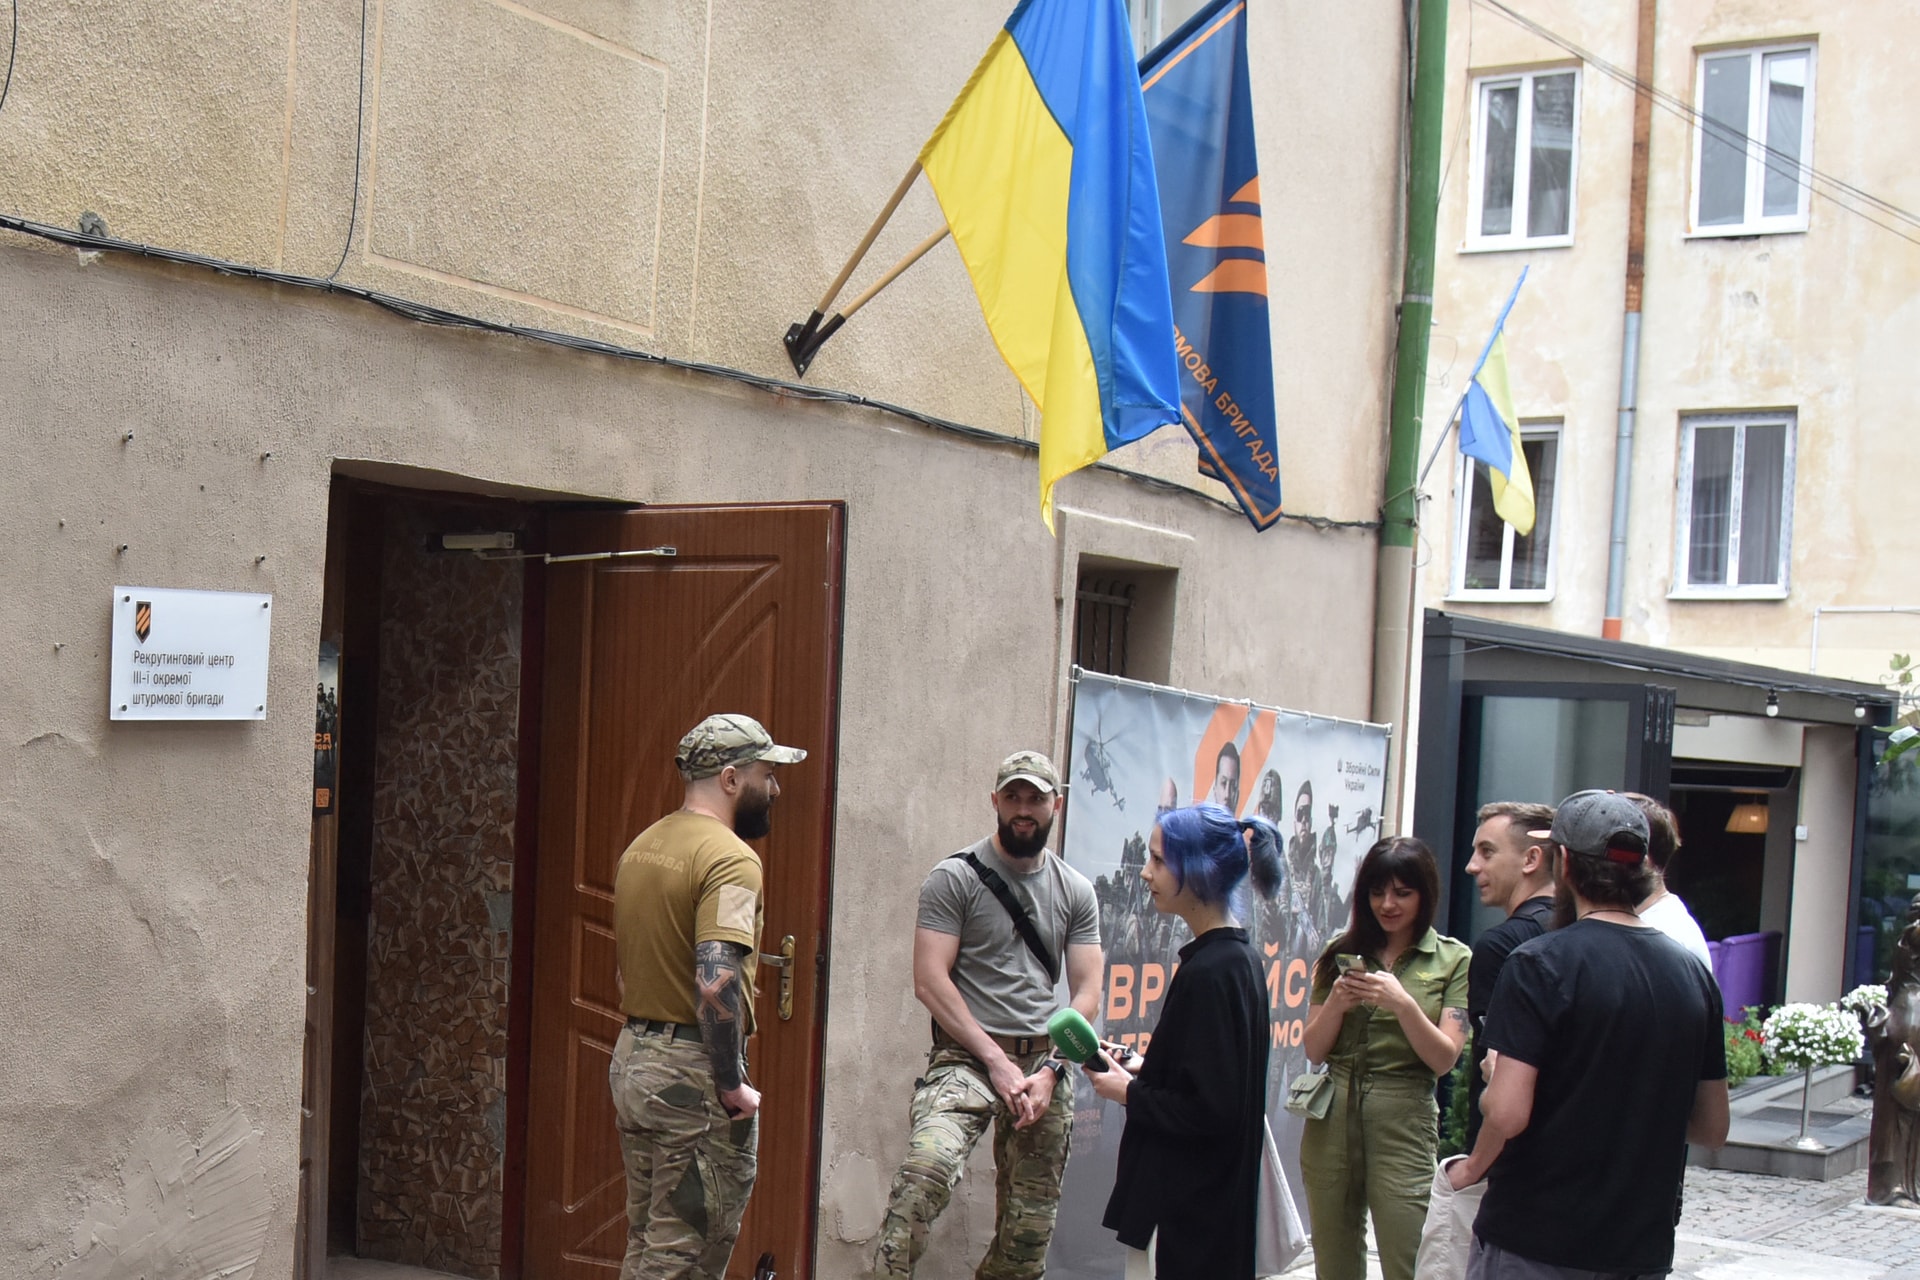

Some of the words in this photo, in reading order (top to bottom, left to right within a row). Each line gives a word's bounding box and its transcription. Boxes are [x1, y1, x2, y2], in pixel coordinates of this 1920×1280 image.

[1214, 391, 1279, 483] БРИГАДА
[133, 650, 205, 668] Рекрутинговий
[208, 654, 235, 669] центр
[153, 671, 192, 687] окремої
[132, 692, 184, 707] штурмової
[186, 692, 224, 707] бригади
